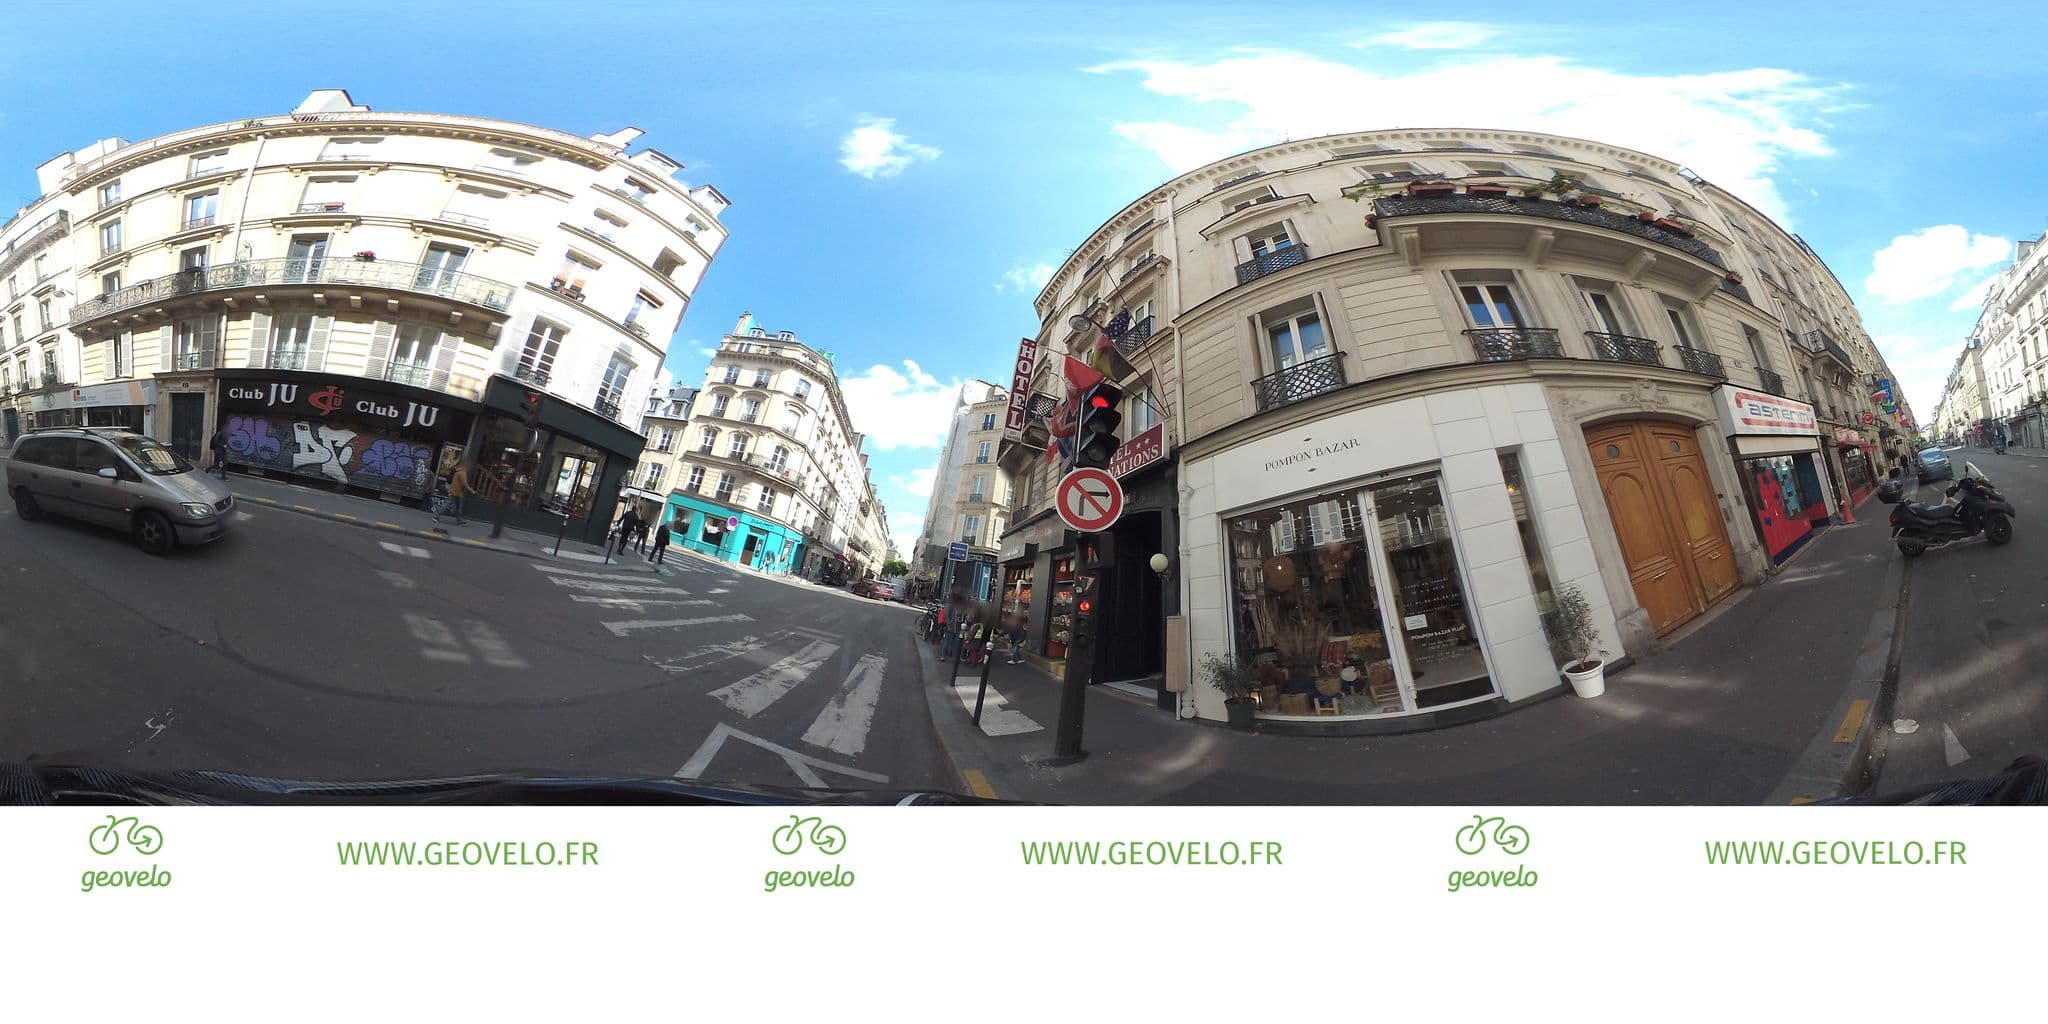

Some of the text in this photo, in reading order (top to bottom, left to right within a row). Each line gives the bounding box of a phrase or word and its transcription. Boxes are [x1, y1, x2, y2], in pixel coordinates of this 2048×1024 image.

[229, 383, 299, 407] Club JU
[1009, 345, 1034, 430] HOTEL
[356, 400, 440, 427] Club JU
[1265, 438, 1360, 471] POMPON BAZAR
